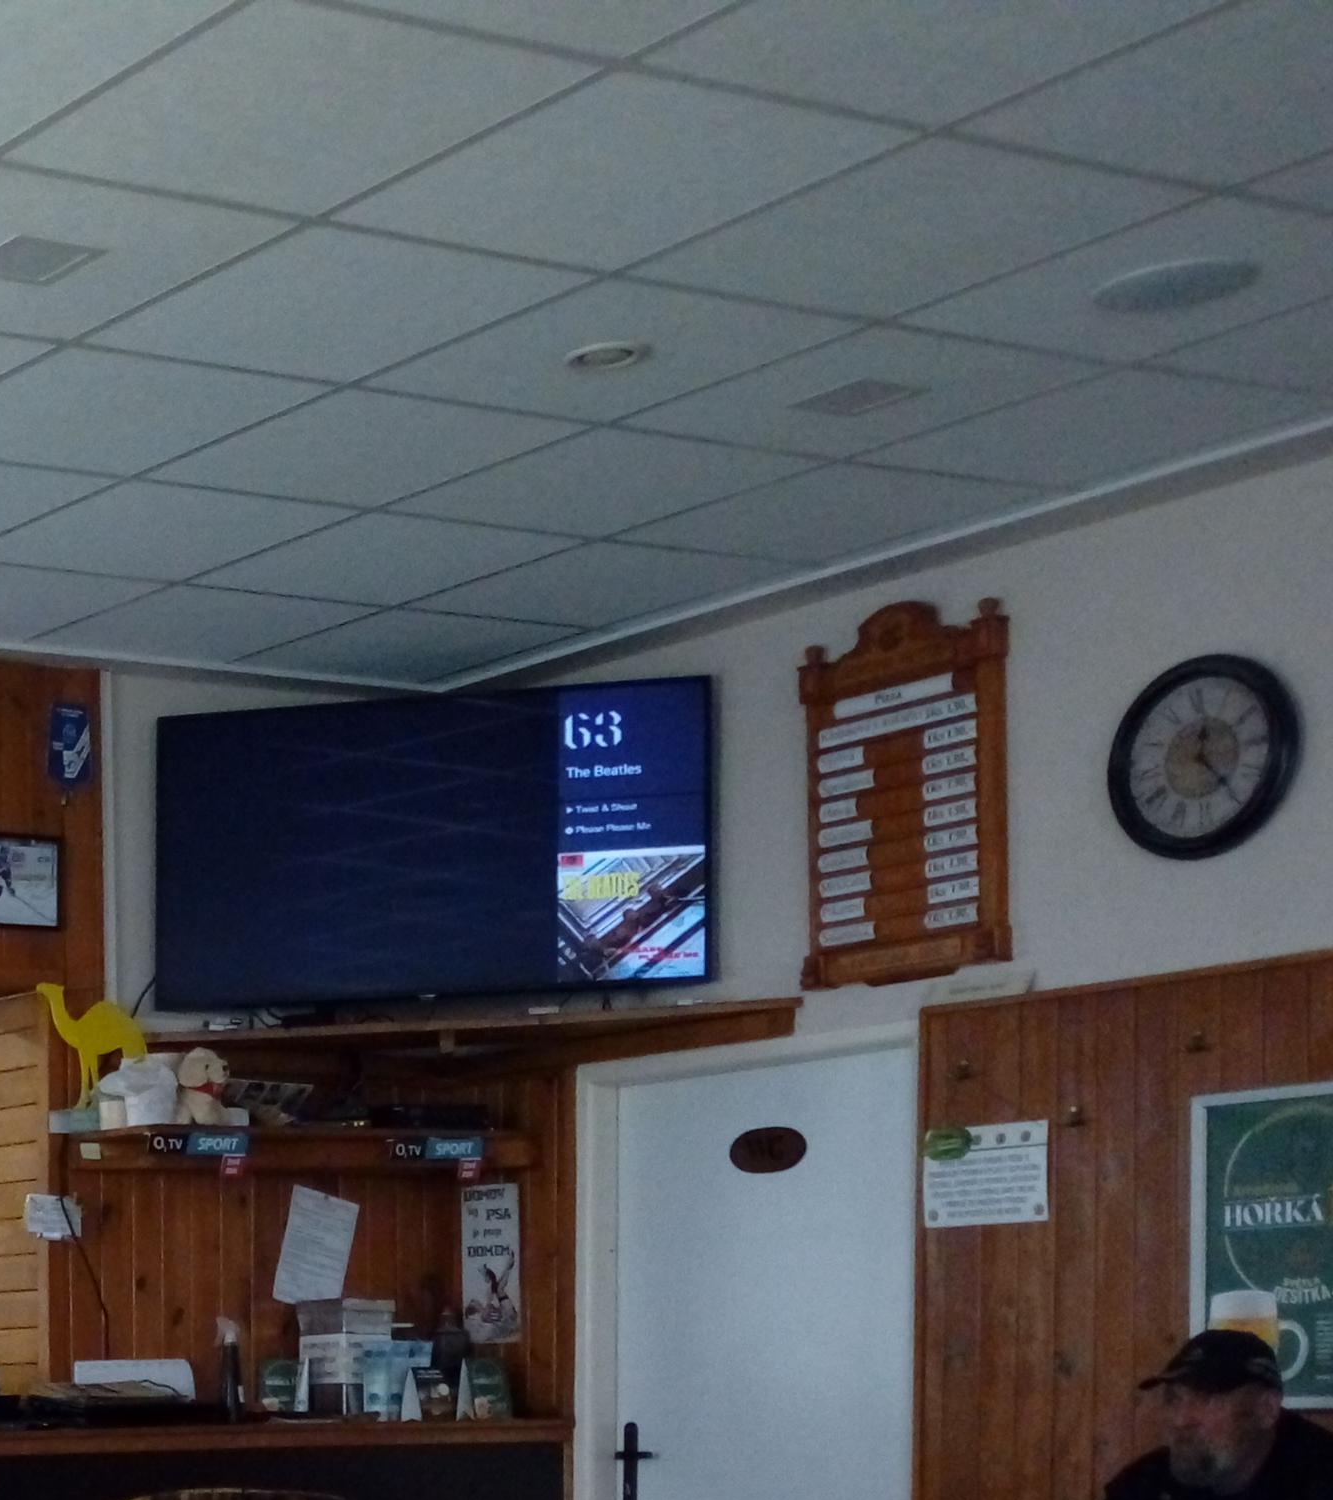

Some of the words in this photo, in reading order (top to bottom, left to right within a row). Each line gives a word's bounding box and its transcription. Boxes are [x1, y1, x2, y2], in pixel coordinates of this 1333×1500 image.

[564, 711, 623, 750] 63
[565, 765, 591, 779] The
[593, 763, 643, 778] Beatles
[196, 1137, 239, 1151] SPORT
[435, 1142, 474, 1156] SPORT
[485, 1208, 512, 1222] PSA
[1223, 1194, 1324, 1229] HOŘKÁ
